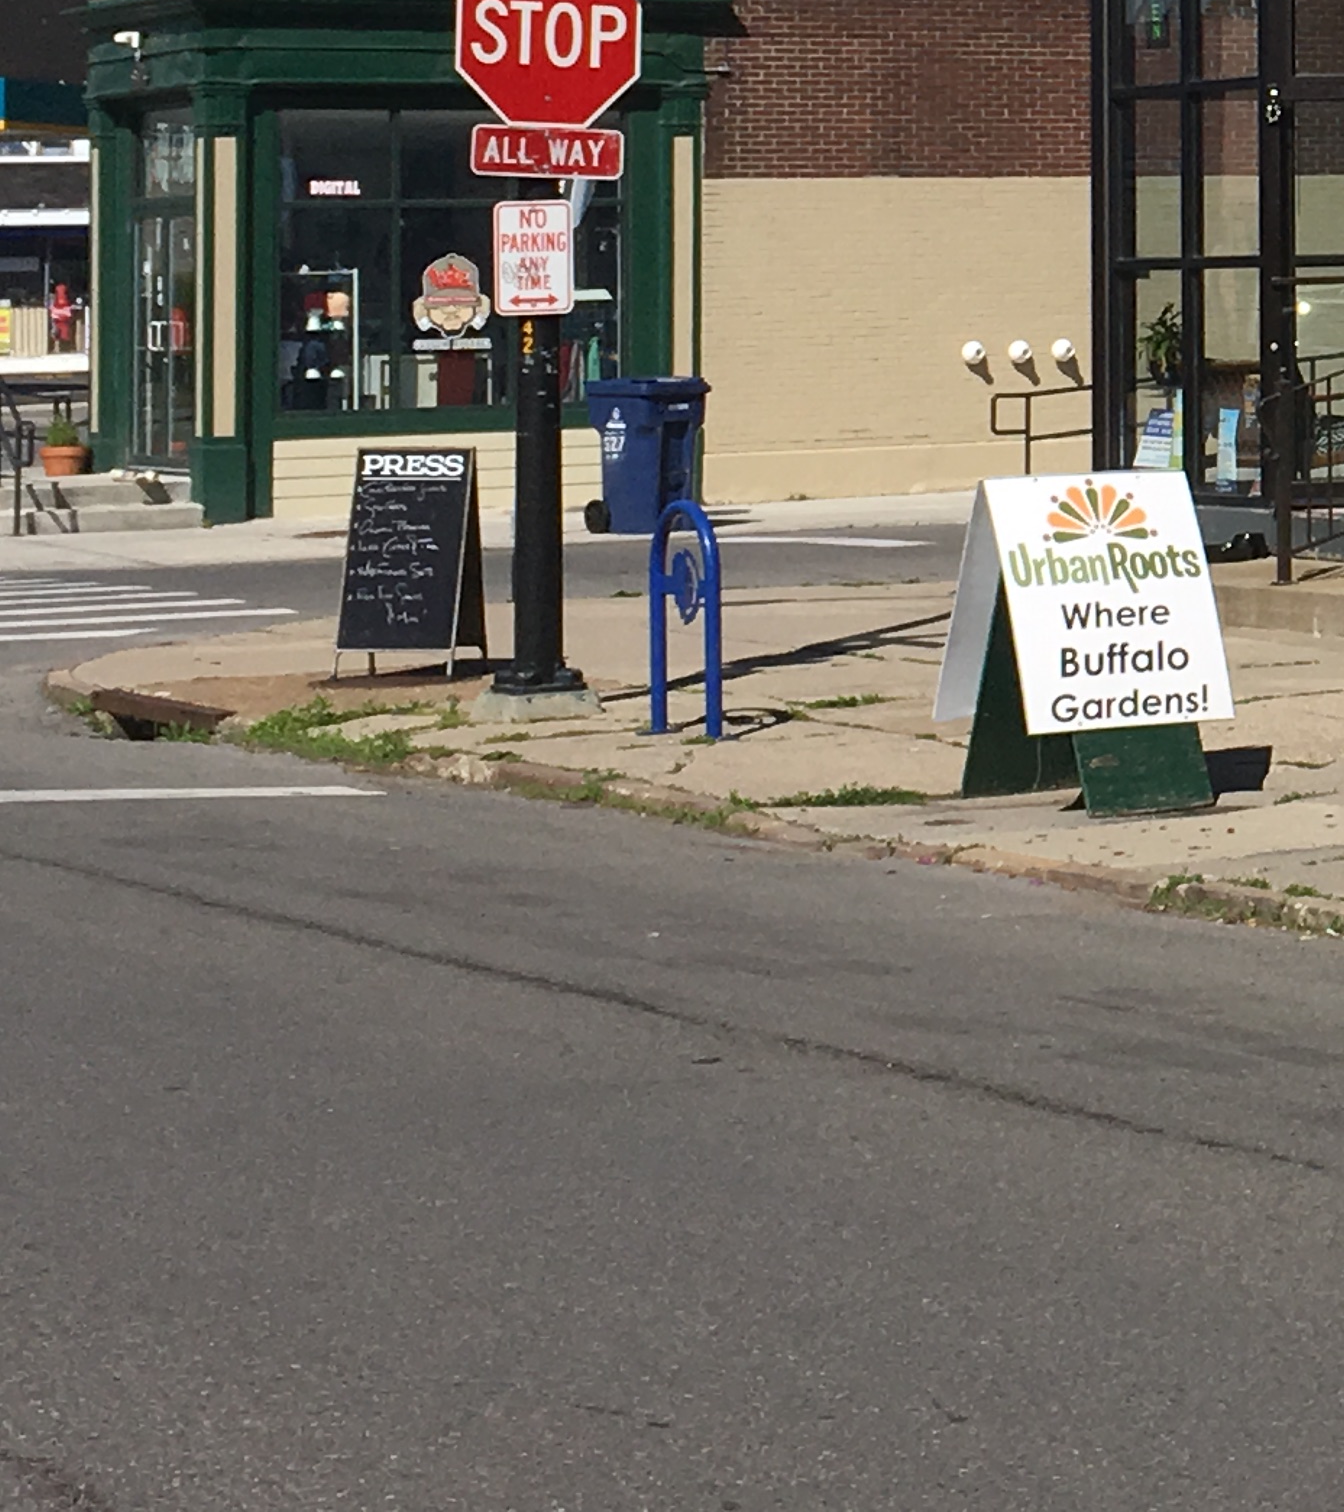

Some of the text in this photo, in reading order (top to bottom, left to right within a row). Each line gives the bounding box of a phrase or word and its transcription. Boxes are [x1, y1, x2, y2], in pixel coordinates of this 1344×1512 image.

[482, 136, 606, 167] ALL WAY
[309, 179, 361, 196] DIGITAL
[519, 207, 548, 229] NO
[501, 232, 567, 253] PARKING
[518, 256, 550, 273] ANY
[517, 275, 552, 290] TIME
[361, 454, 465, 477] PRESS
[1061, 601, 1171, 630] Where
[1060, 640, 1190, 678] Buffalo
[1051, 683, 1209, 723] Gardens!
